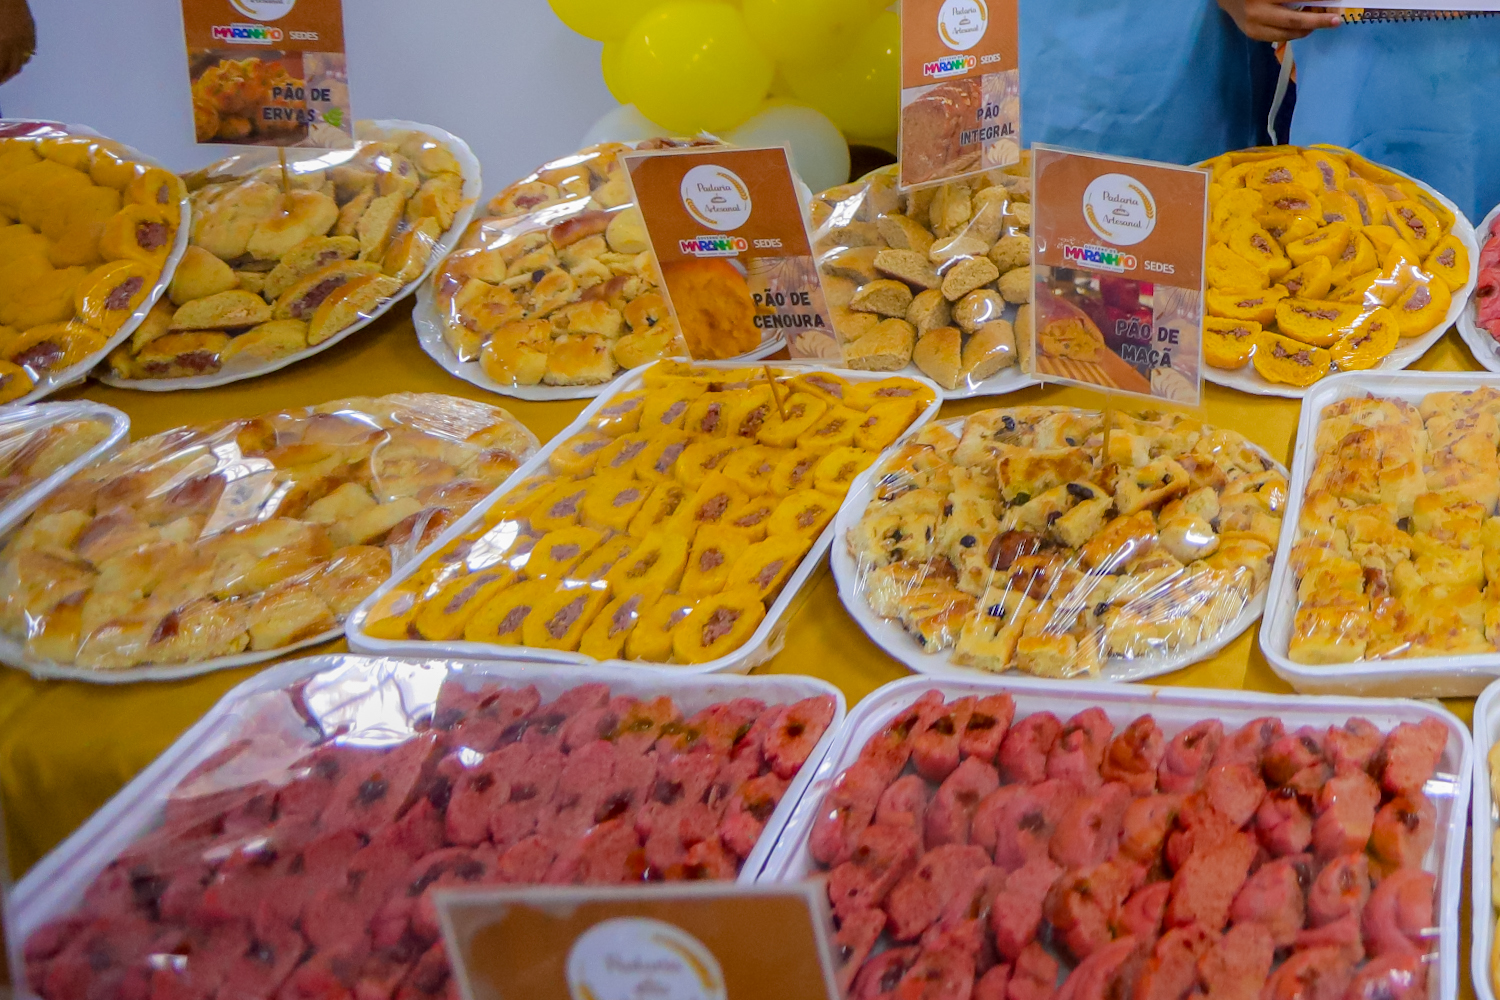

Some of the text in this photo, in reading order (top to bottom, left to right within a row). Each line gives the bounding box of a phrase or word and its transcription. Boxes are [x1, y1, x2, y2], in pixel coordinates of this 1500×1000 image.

[952, 7, 977, 16] Padaria
[289, 31, 319, 41] SEDES
[952, 24, 979, 35] Artesanal
[980, 53, 1001, 65] SEDES
[272, 83, 331, 101] PÃO DE
[263, 107, 316, 123] ERVAS
[976, 102, 1000, 121] PÃO
[960, 122, 1015, 146] INTEGRAL
[697, 183, 732, 193] Padaria
[1103, 190, 1139, 206] Padaria
[704, 204, 741, 213] Artesanal
[1103, 213, 1142, 228] Artesanal
[753, 238, 782, 248] SEDES
[1144, 260, 1175, 274] SEDES
[753, 288, 811, 307] PÃO DE
[753, 314, 825, 329] CENOURA
[1116, 318, 1180, 345] PÃO DE
[1121, 344, 1172, 368] MAÇÃ
